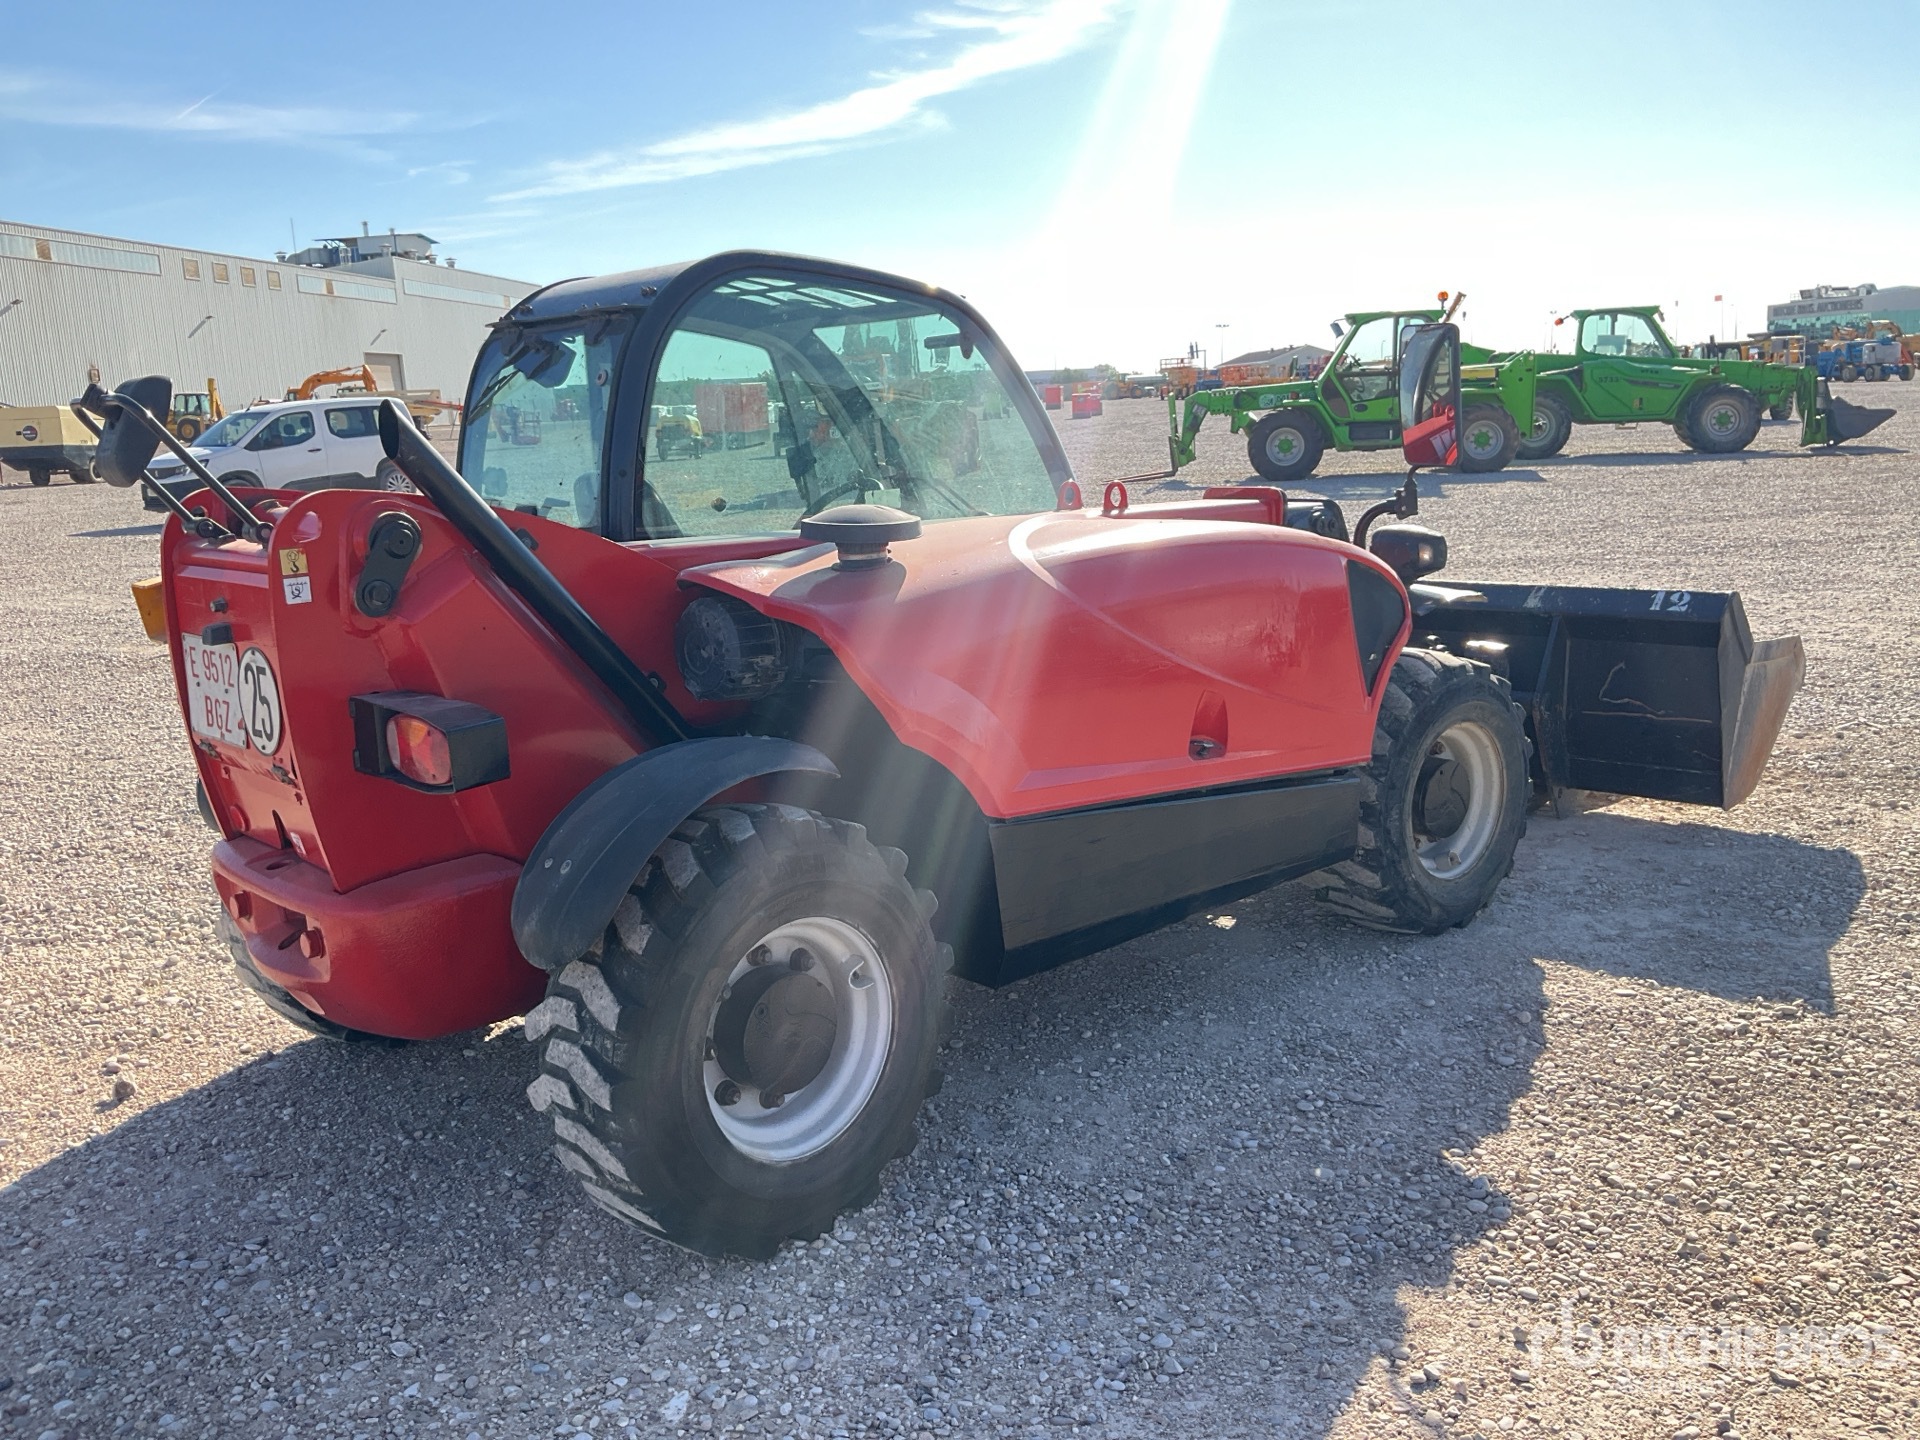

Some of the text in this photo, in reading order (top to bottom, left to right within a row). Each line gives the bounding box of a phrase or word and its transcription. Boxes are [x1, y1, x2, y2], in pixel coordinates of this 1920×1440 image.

[1650, 590, 1691, 612] 12
[188, 646, 235, 689] E 9512
[204, 695, 233, 734] BGZ
[244, 662, 273, 743] 25
